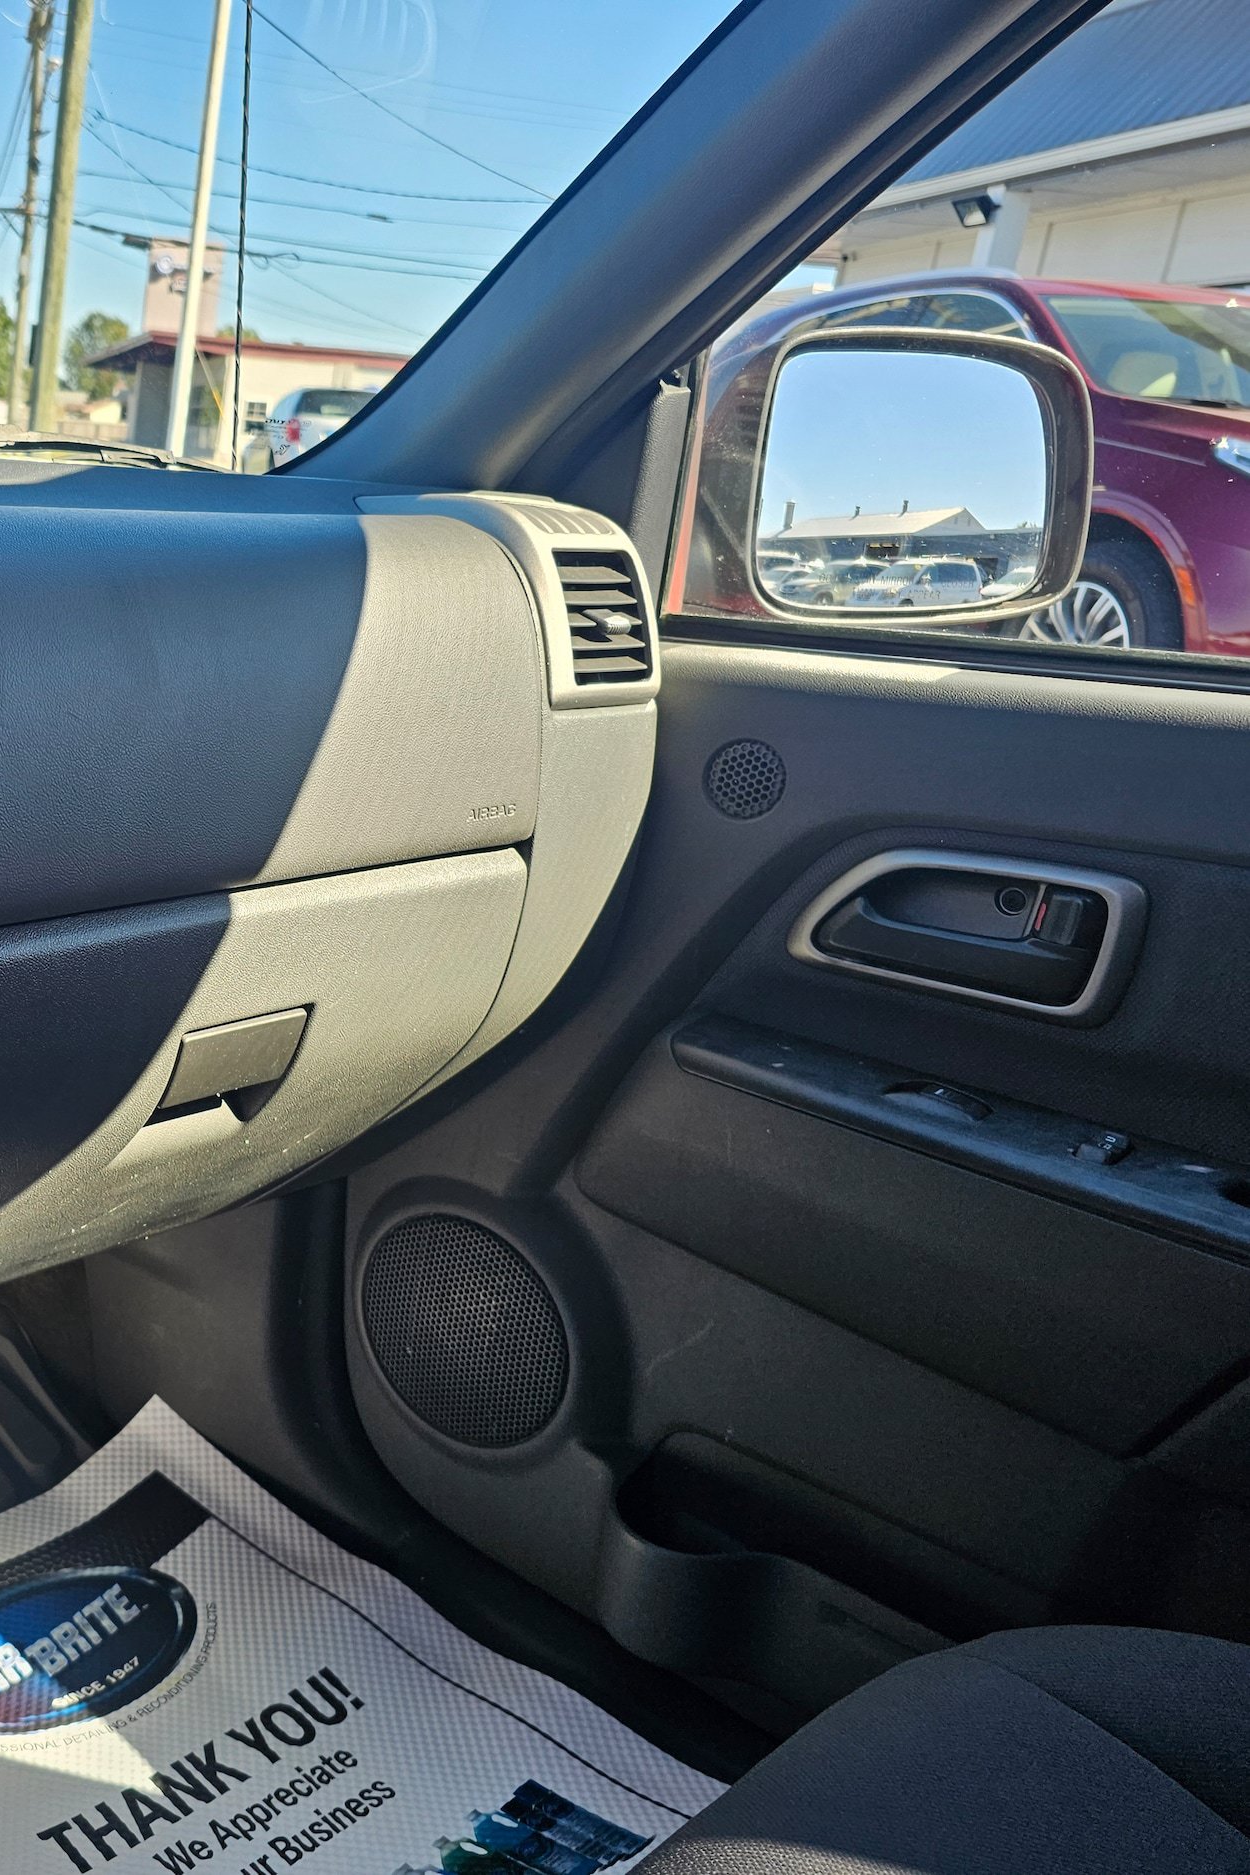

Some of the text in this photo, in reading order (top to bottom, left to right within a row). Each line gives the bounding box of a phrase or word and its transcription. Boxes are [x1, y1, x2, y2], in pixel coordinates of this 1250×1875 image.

[467, 803, 517, 822] AIRBAG
[24, 1582, 141, 1677] BRITE
[63, 1718, 127, 1746] DETAILING
[126, 1713, 138, 1723] &
[135, 1654, 207, 1718] RECONDITIONING
[201, 1601, 218, 1656] PRODUCTS
[51, 1656, 140, 1709] SINCE 1947
[36, 1666, 366, 1874] THANK YOU!
[152, 1750, 358, 1875] We Appreciate
[268, 1780, 396, 1866] Business
